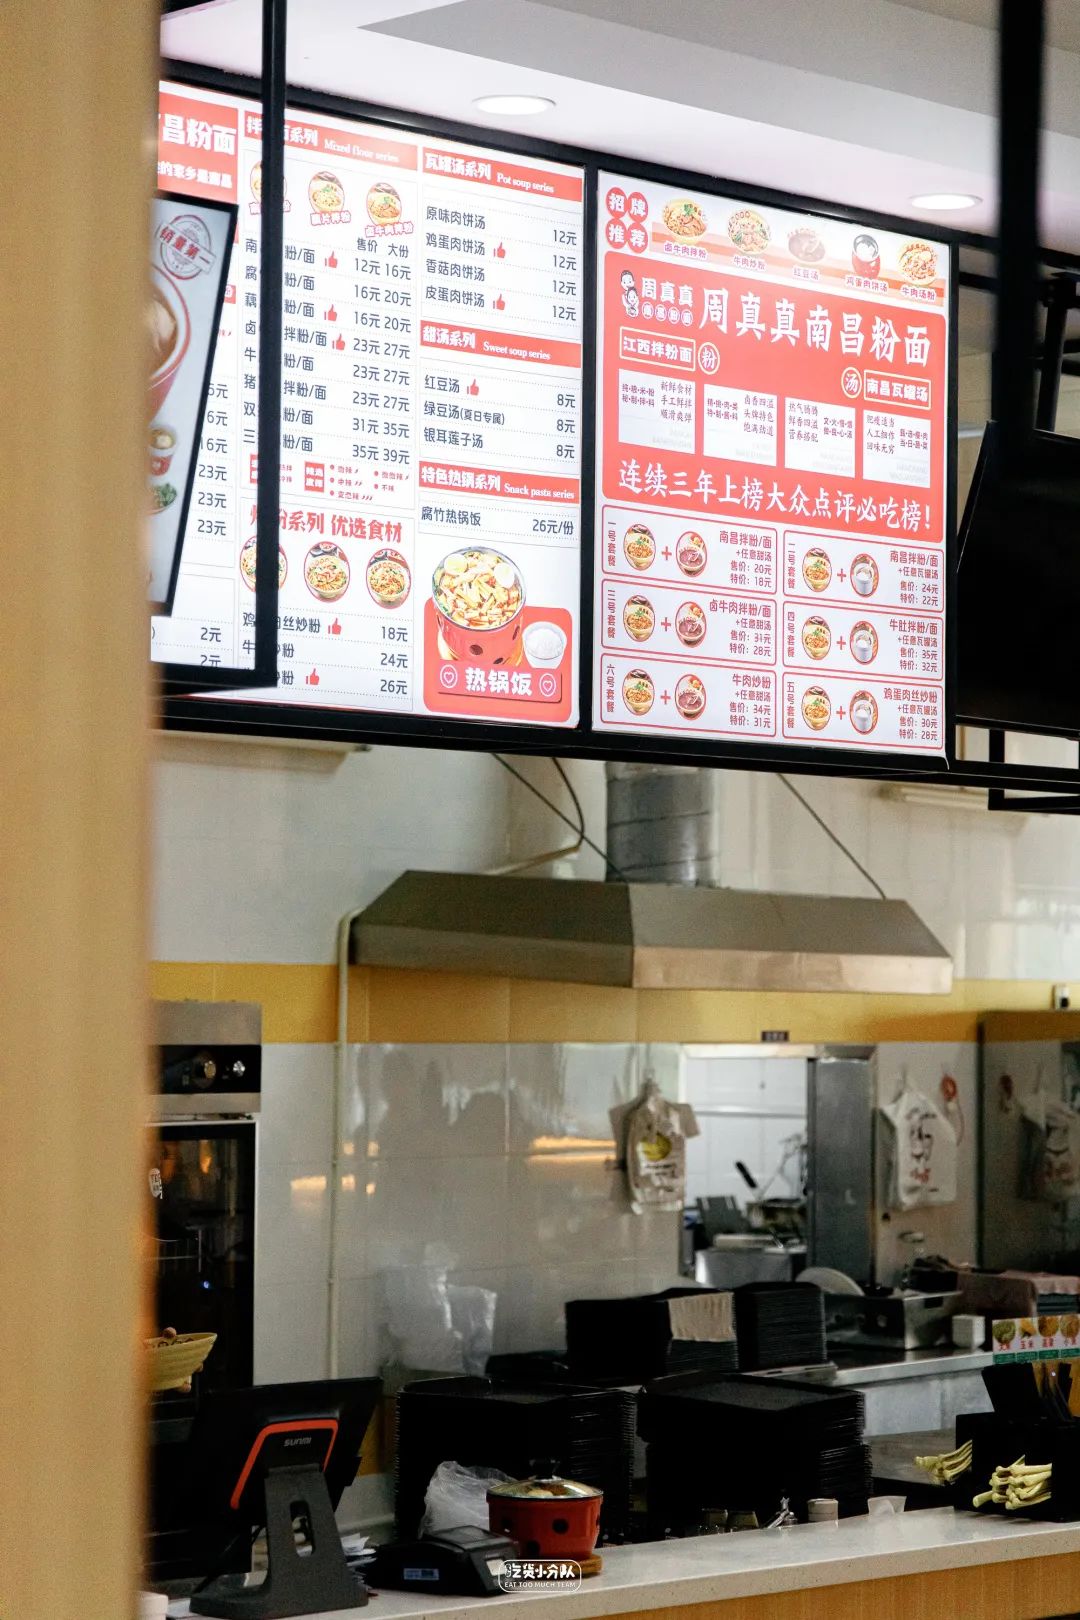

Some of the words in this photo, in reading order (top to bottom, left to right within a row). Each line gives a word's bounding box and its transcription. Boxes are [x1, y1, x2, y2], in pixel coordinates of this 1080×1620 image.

[158, 113, 236, 155] 昌粉面
[245, 115, 318, 147] 拌系列
[426, 152, 491, 180] 瓦罐汤系列
[497, 172, 511, 184] Pot
[513, 177, 531, 191] soup
[532, 181, 554, 193] series
[426, 206, 485, 230] 原味肉饼汤
[609, 193, 646, 218] 招牌
[356, 237, 379, 254] 售价
[388, 243, 409, 259] 大份
[553, 229, 577, 246] 12元
[608, 224, 645, 248] 推荐
[245, 238, 315, 265] 南粉/面
[354, 258, 381, 275] 12元
[385, 263, 412, 281] 16元
[425, 232, 485, 256] 鸡蛋肉饼汤
[553, 254, 577, 271] 12元
[244, 265, 315, 291] 腐粉/面
[354, 284, 381, 302] 16元
[384, 289, 412, 307] 20元
[426, 258, 485, 282] 香菇肉饼汤
[553, 280, 577, 296] 12元
[793, 267, 819, 281] 红豆汤
[425, 285, 485, 308] 皮蛋肉饼汤
[553, 305, 577, 321] 12元
[641, 277, 693, 307] 周真真
[244, 291, 315, 318] 藕粉/面
[354, 311, 381, 329] 16元
[384, 316, 412, 333] 20元
[699, 287, 931, 367] 周真真南昌粉面
[244, 319, 327, 346] 卤拌粉/面
[353, 337, 380, 355] 23元
[384, 343, 411, 360] 27元
[423, 325, 476, 349] 甜汤系列
[483, 341, 508, 354] Sweet
[509, 347, 527, 359] soup
[529, 350, 551, 361] series
[623, 336, 692, 363] 江西拌粉面
[701, 347, 718, 369] 粉
[244, 346, 314, 371] 牛粉/面
[353, 365, 380, 382] 23元
[383, 369, 411, 386] 27元
[244, 373, 327, 400] 猪拌粉/面
[352, 391, 380, 408] 23元
[383, 396, 410, 412] 27元
[424, 374, 460, 394] 红豆汤
[557, 393, 576, 409] 8元
[845, 372, 859, 393] 汤
[866, 378, 928, 402] 南昌瓦罐汤
[244, 401, 314, 426] 双粉/面
[352, 418, 379, 434] 31元
[383, 423, 410, 439] 35元
[556, 419, 576, 434] 8元
[243, 428, 313, 452] 三粉/面
[352, 444, 379, 461] 35元
[383, 450, 410, 465] 39元
[423, 426, 484, 449] 银耳莲子汤
[556, 444, 575, 459] 8元
[198, 464, 227, 481] 23元
[421, 466, 500, 491] 特色热锅系列
[504, 483, 529, 496] Snack
[553, 489, 575, 499] series
[198, 491, 227, 509] 23元
[619, 458, 930, 532] 连续三年上榜大众点评必吃榜！
[197, 519, 227, 537] 23元
[331, 514, 402, 544] 优选食材
[421, 506, 481, 526] 腐竹热锅饭
[532, 519, 574, 536] 26元/份
[719, 530, 772, 549] 南昌拌粉/面
[890, 550, 938, 567] 南昌拌粉/面
[709, 598, 771, 617] 卤牛肉拌粉/面
[200, 627, 222, 643] 2元
[243, 612, 320, 634] 鸡丝炒粉
[381, 627, 408, 642] 18元
[889, 619, 938, 635] 牛肚拌粉/面
[380, 653, 408, 669] 24元
[380, 679, 408, 695] 26元
[465, 667, 532, 696] 热锅饭
[732, 673, 771, 689] 牛肉炒粉
[883, 687, 938, 703] 鸡蛋肉丝炒粉
